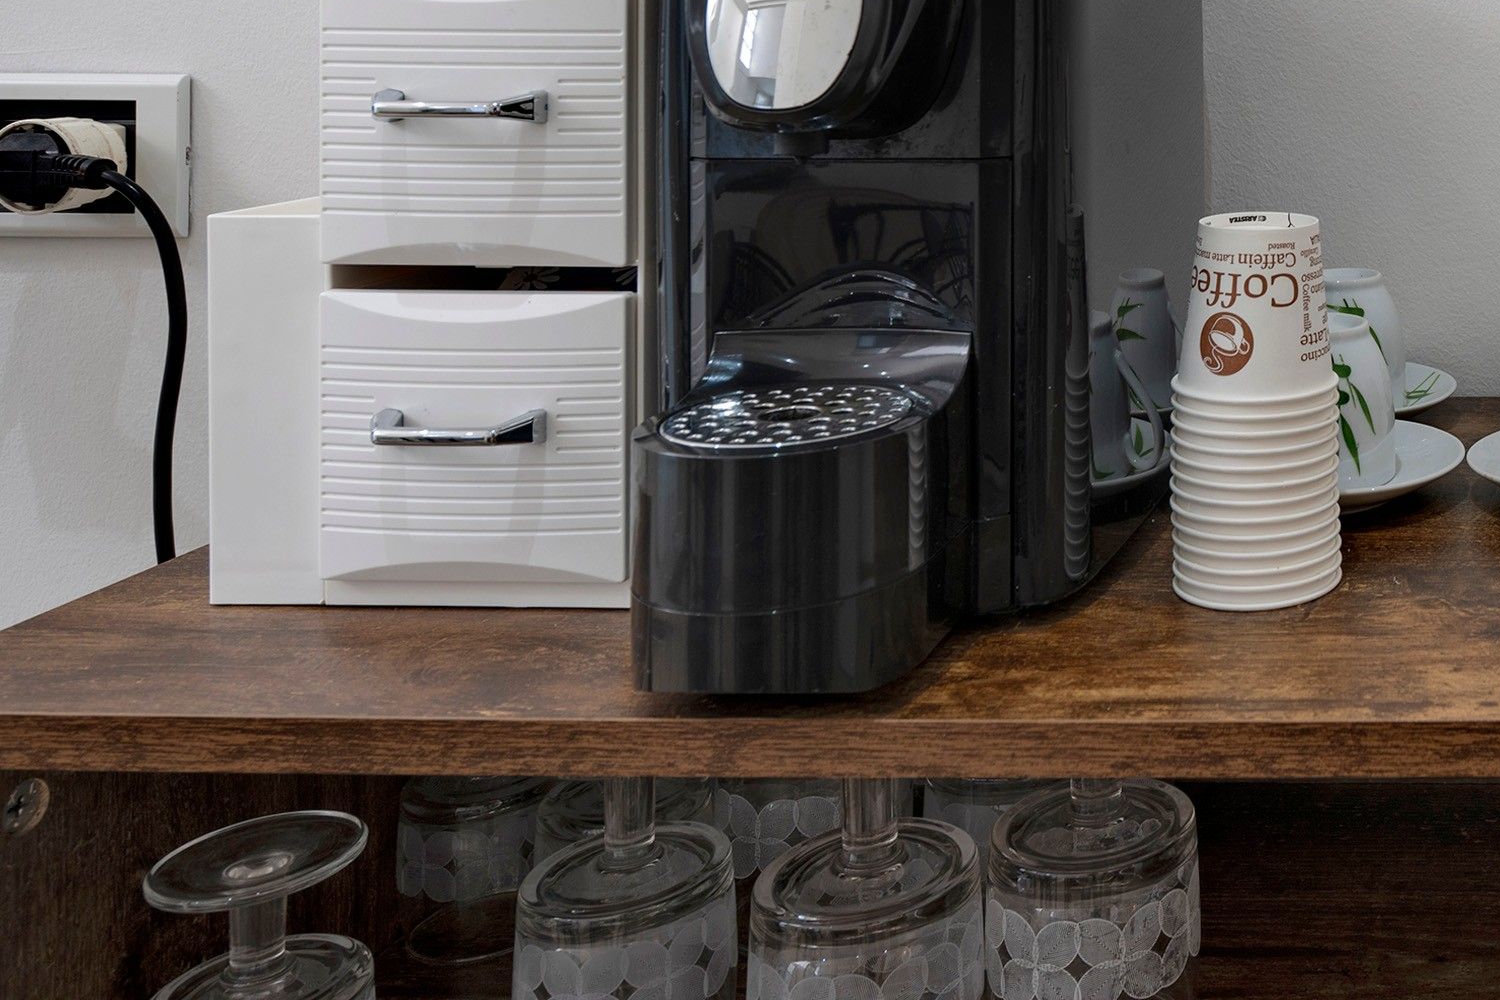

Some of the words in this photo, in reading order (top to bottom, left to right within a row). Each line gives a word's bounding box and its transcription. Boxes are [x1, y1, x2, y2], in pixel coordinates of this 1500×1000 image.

[1268, 242, 1296, 251] Roasted
[1212, 252, 1235, 265] Latte
[1238, 252, 1297, 269] Caffein
[1191, 264, 1299, 309] Coffee
[1302, 283, 1311, 311] Coffee
